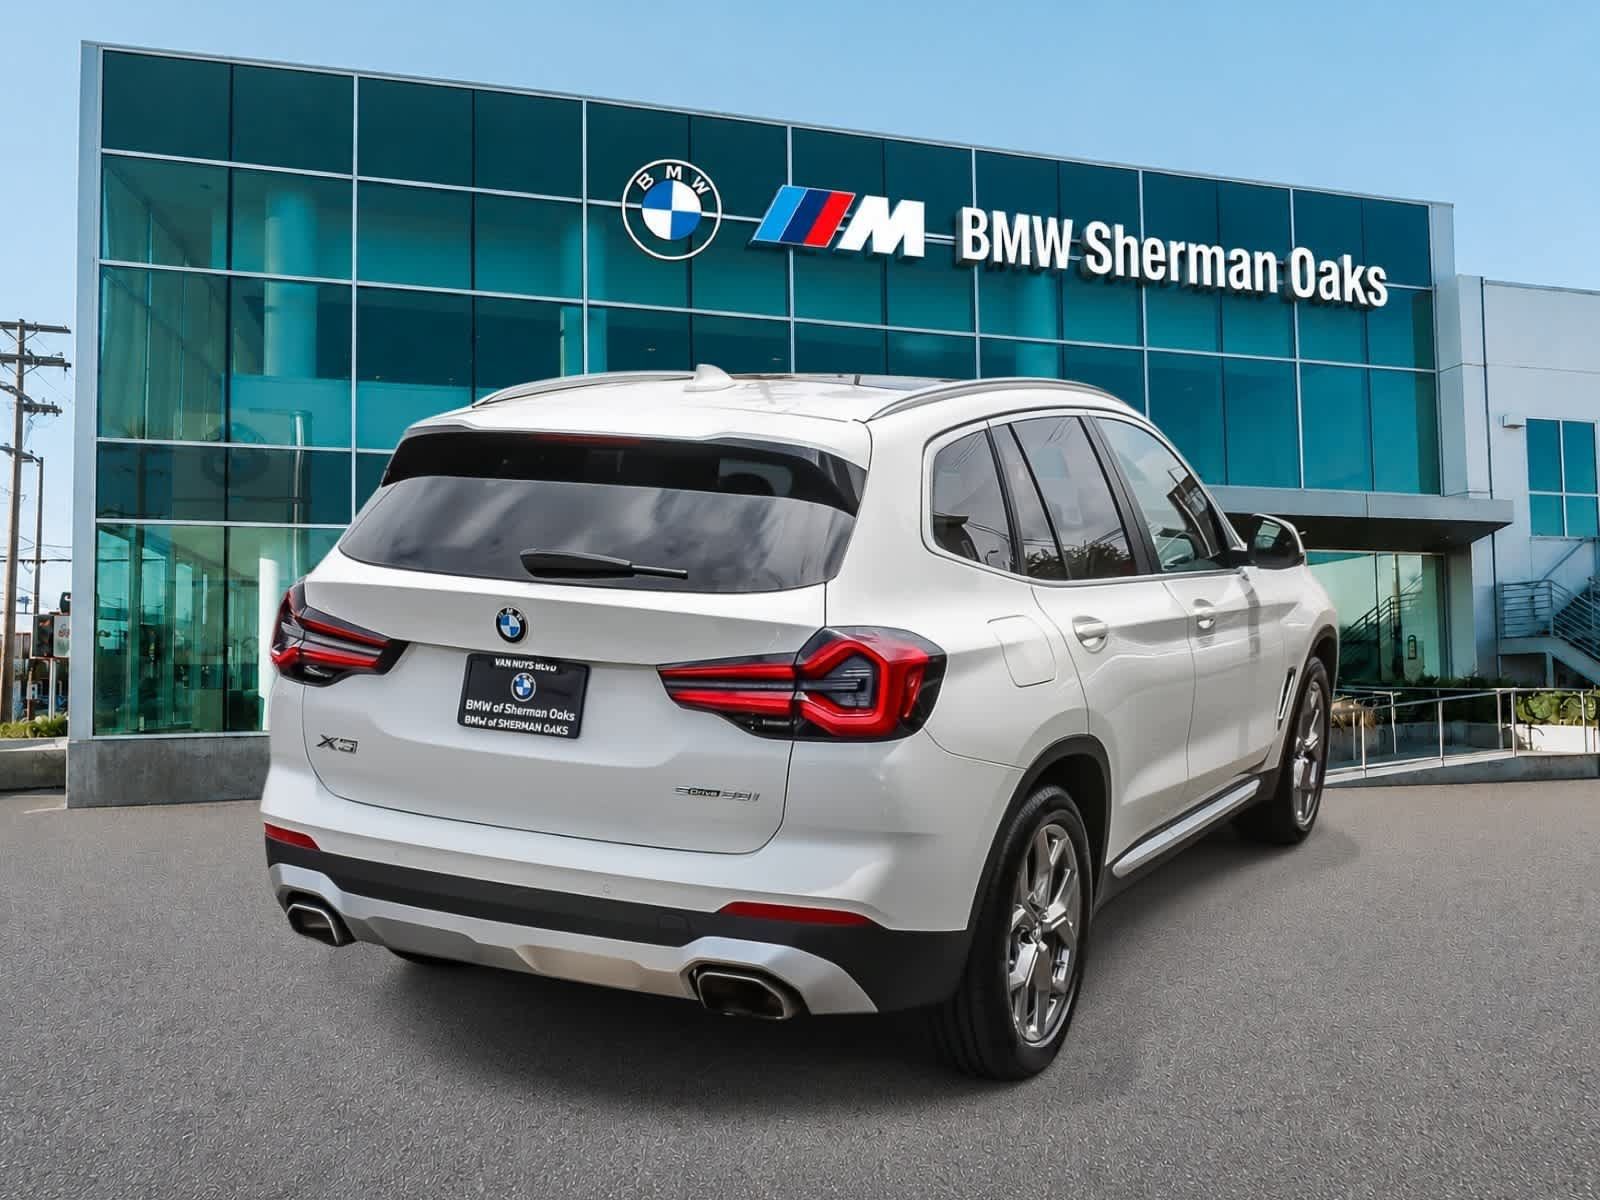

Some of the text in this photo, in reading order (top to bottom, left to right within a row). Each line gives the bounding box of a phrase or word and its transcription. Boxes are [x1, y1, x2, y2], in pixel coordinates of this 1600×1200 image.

[636, 165, 711, 195] BMW
[836, 195, 925, 258] M
[960, 206, 1389, 308] BMW Sherman Oaks
[495, 658, 511, 668] VAN
[511, 660, 534, 670] NUYS
[465, 700, 575, 721] BMW of Sherman Oaks
[464, 715, 569, 735] BMW of SHERMAN OAKS
[316, 734, 358, 754] X3
